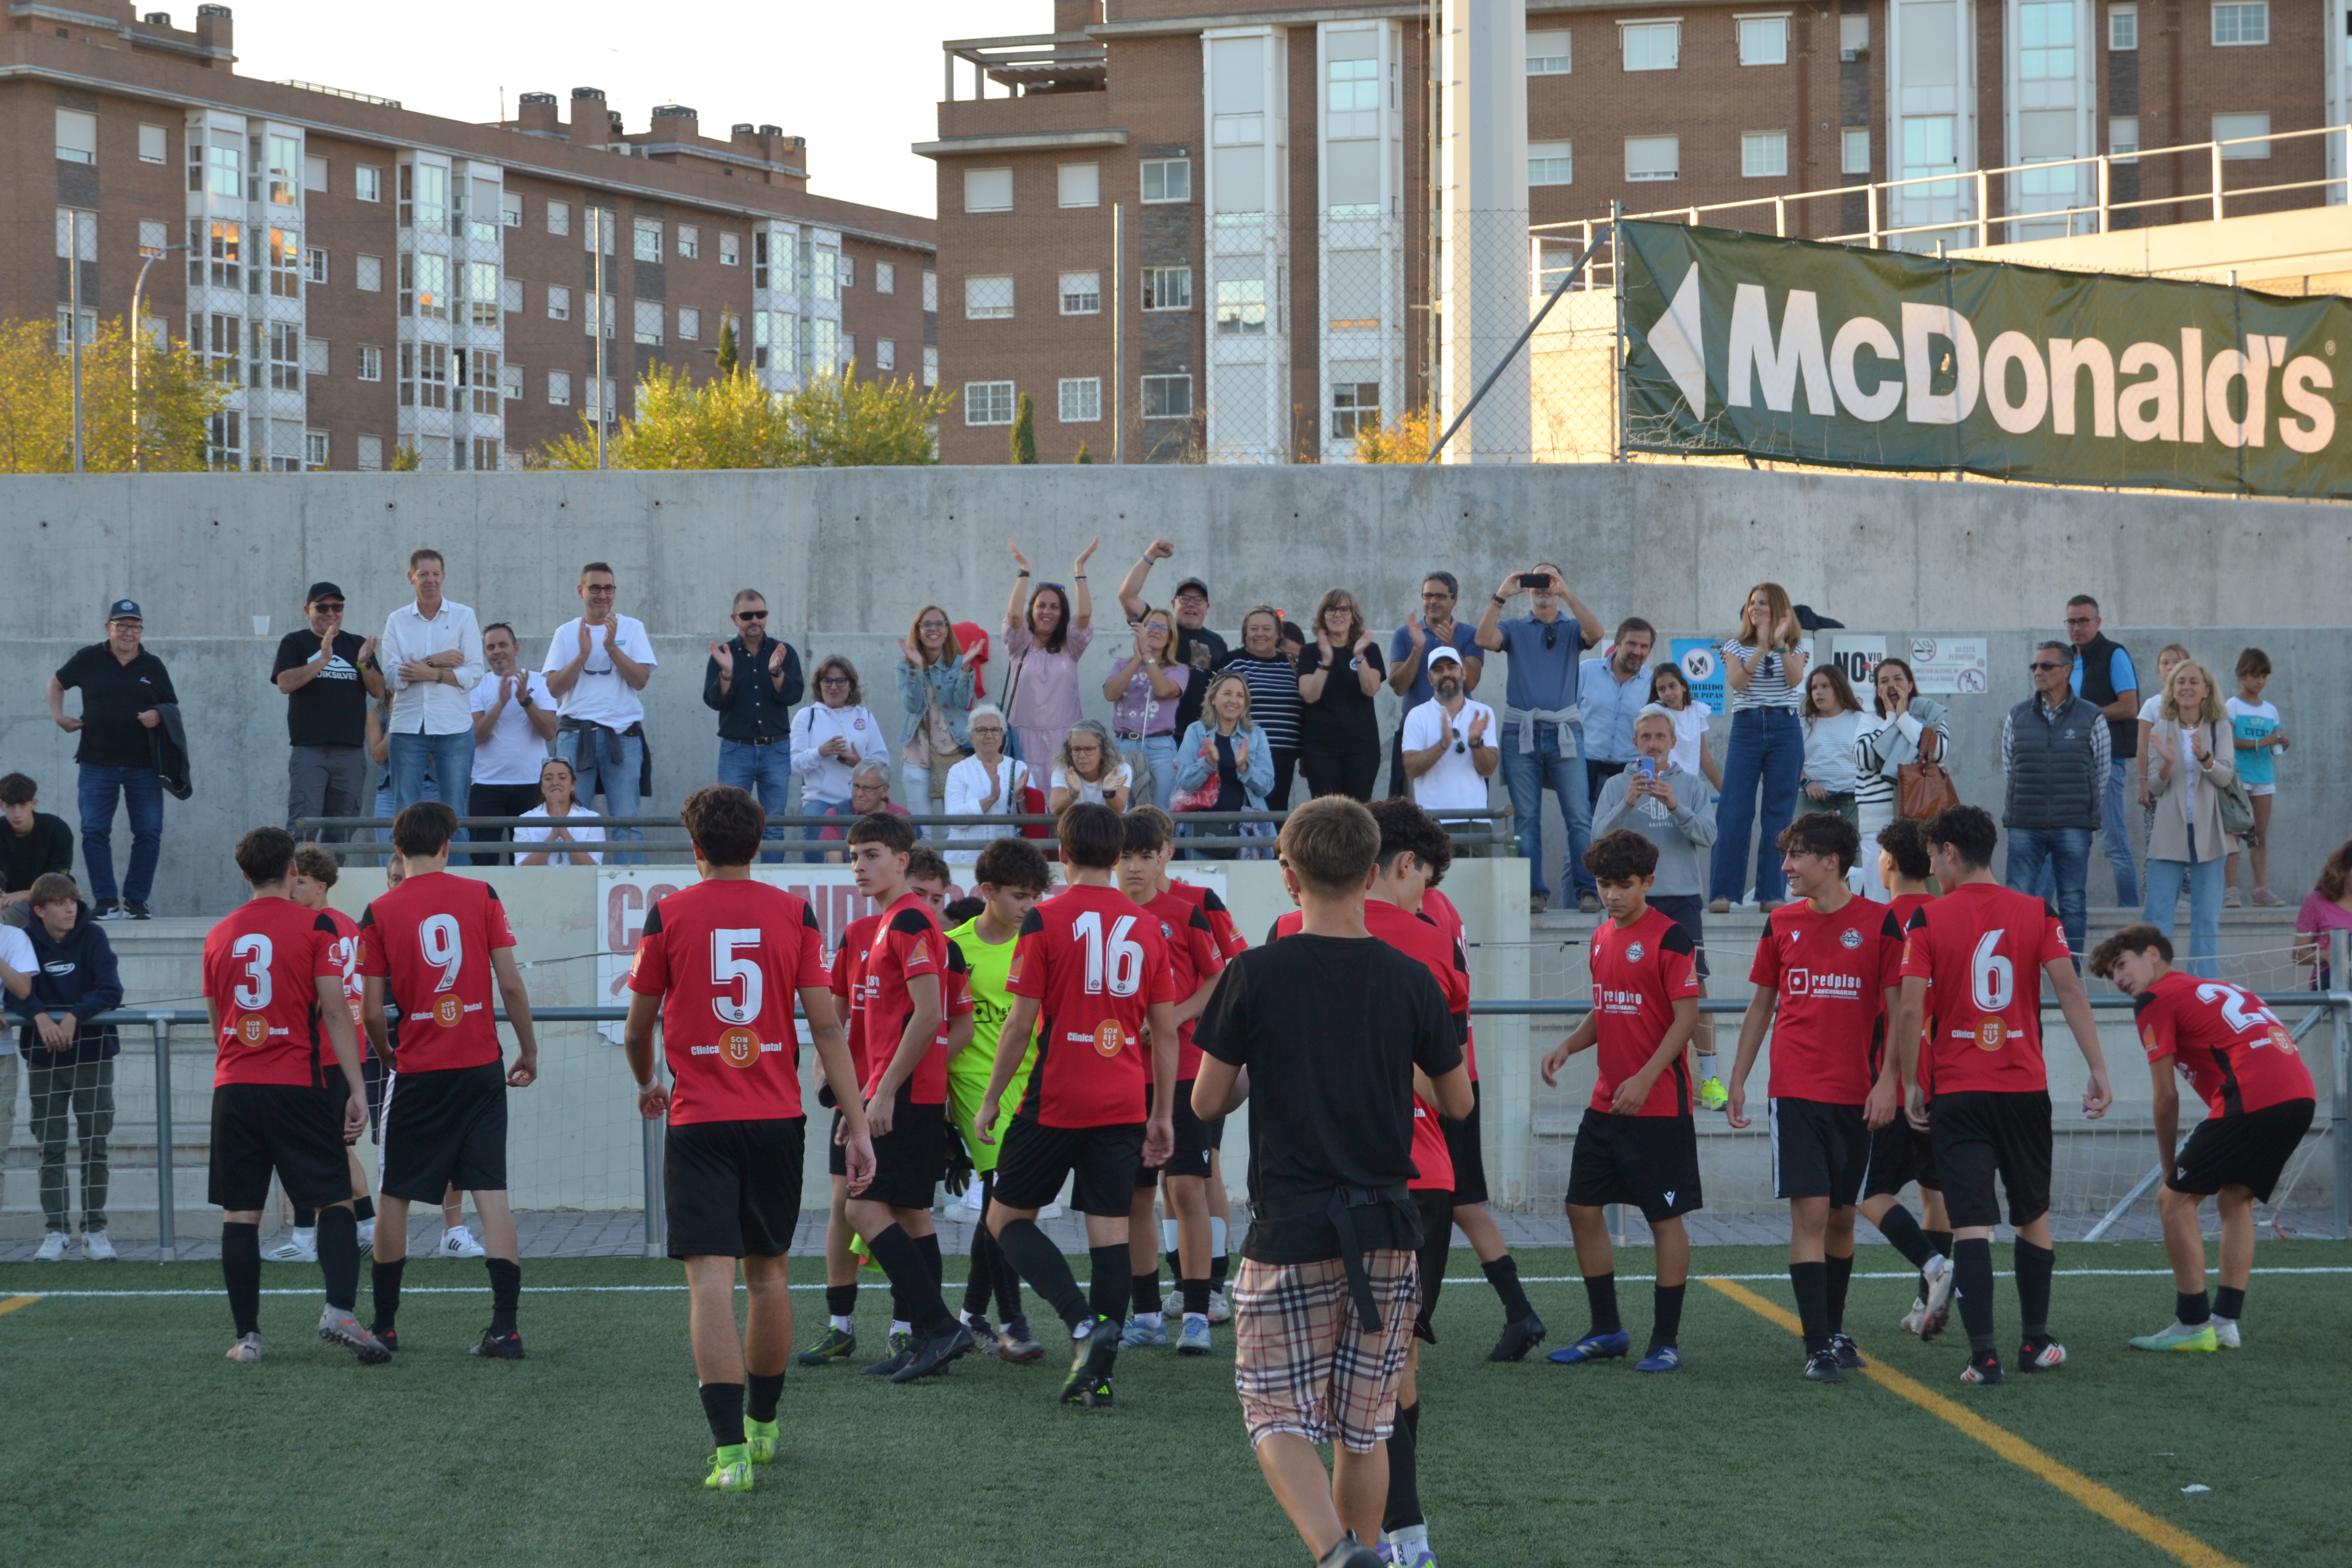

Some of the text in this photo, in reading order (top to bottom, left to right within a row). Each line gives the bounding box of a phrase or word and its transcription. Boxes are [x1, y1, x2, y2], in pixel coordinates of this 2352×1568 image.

[1728, 283, 2335, 453] McDonald's
[309, 671, 357, 681] UIKSILVER
[1868, 652, 1882, 662] VIO
[232, 933, 273, 1010] 3
[419, 913, 462, 992] 9
[710, 928, 763, 1025] 5
[1072, 911, 1144, 997] 16
[1812, 973, 1861, 988] redpiso
[1971, 928, 2013, 1012] 6
